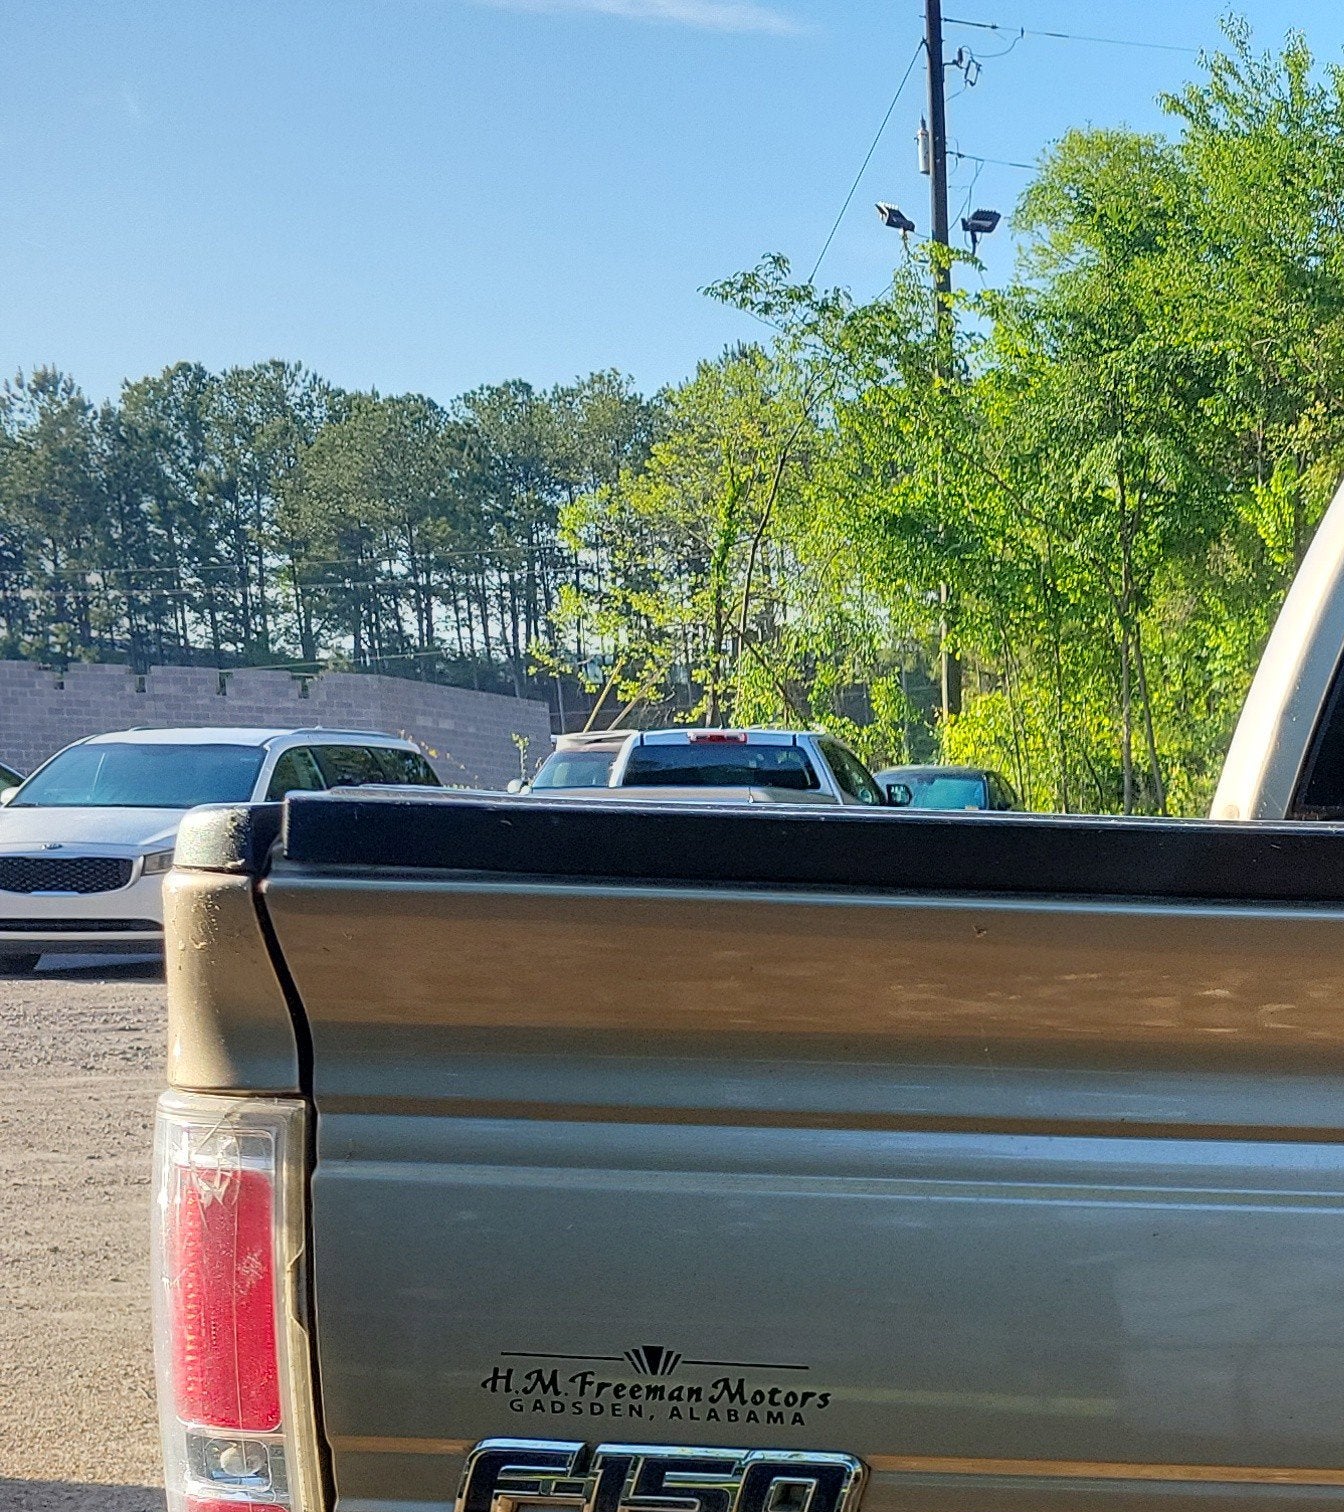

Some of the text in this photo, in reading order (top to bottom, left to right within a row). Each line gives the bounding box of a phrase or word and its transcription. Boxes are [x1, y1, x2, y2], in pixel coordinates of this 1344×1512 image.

[708, 1376, 832, 1409] Motors
[508, 1398, 806, 1427] GADSDEN, ALABAMA
